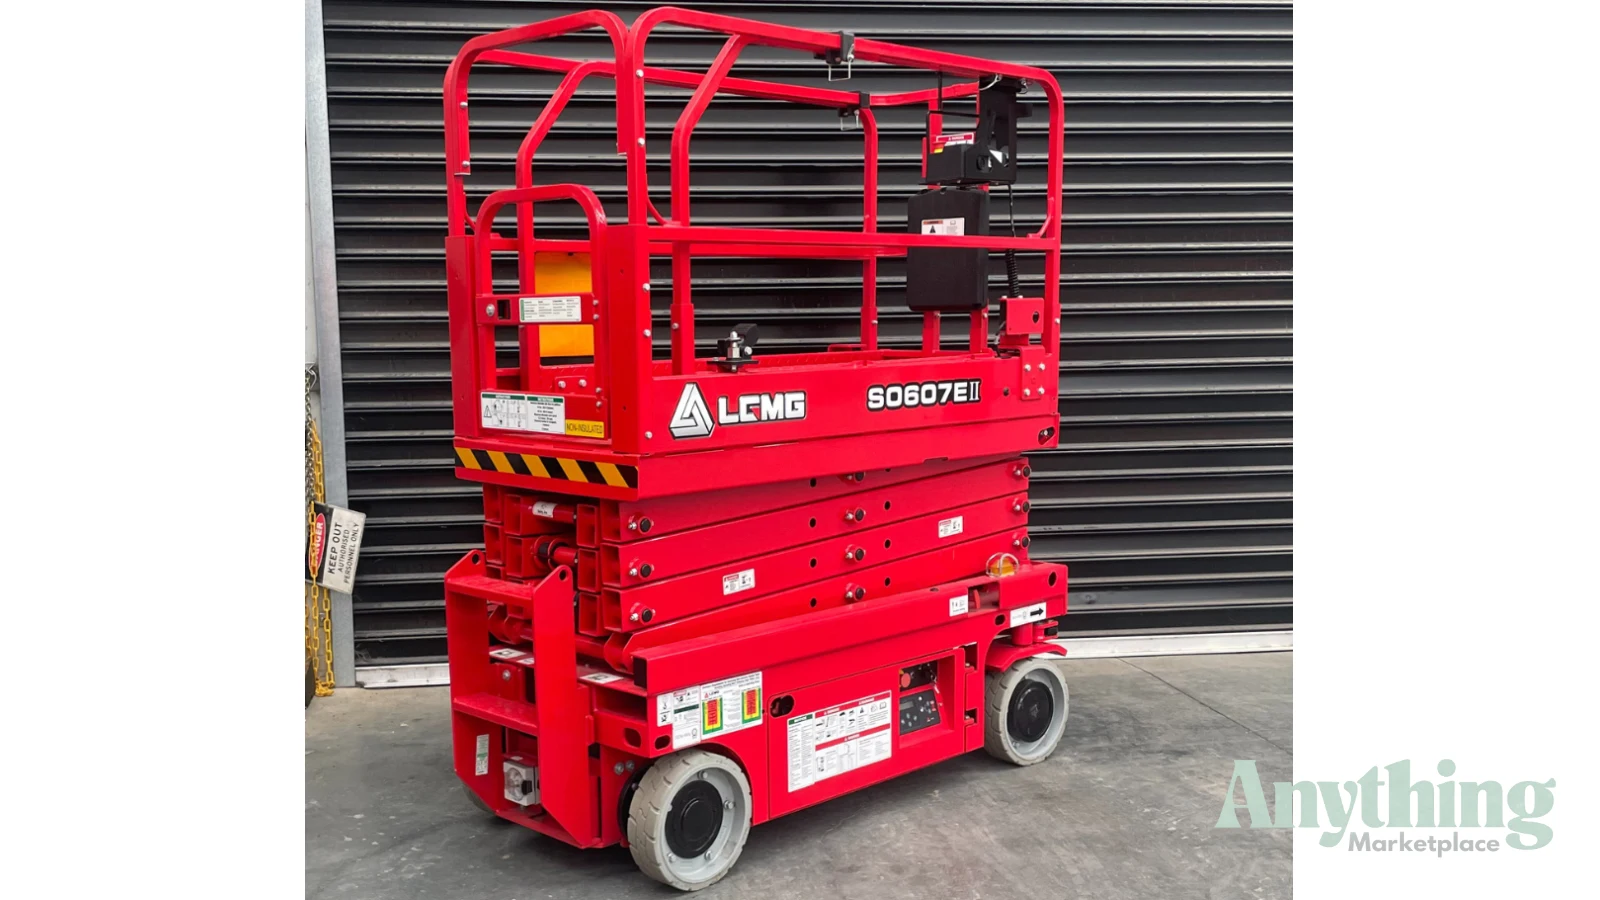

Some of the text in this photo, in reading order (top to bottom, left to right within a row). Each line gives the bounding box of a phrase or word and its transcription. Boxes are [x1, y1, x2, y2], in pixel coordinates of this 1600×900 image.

[328, 522, 342, 574] KEEP OUT
[338, 529, 350, 573] AUTHORISED
[344, 522, 360, 584] PERSONNEL ONLY
